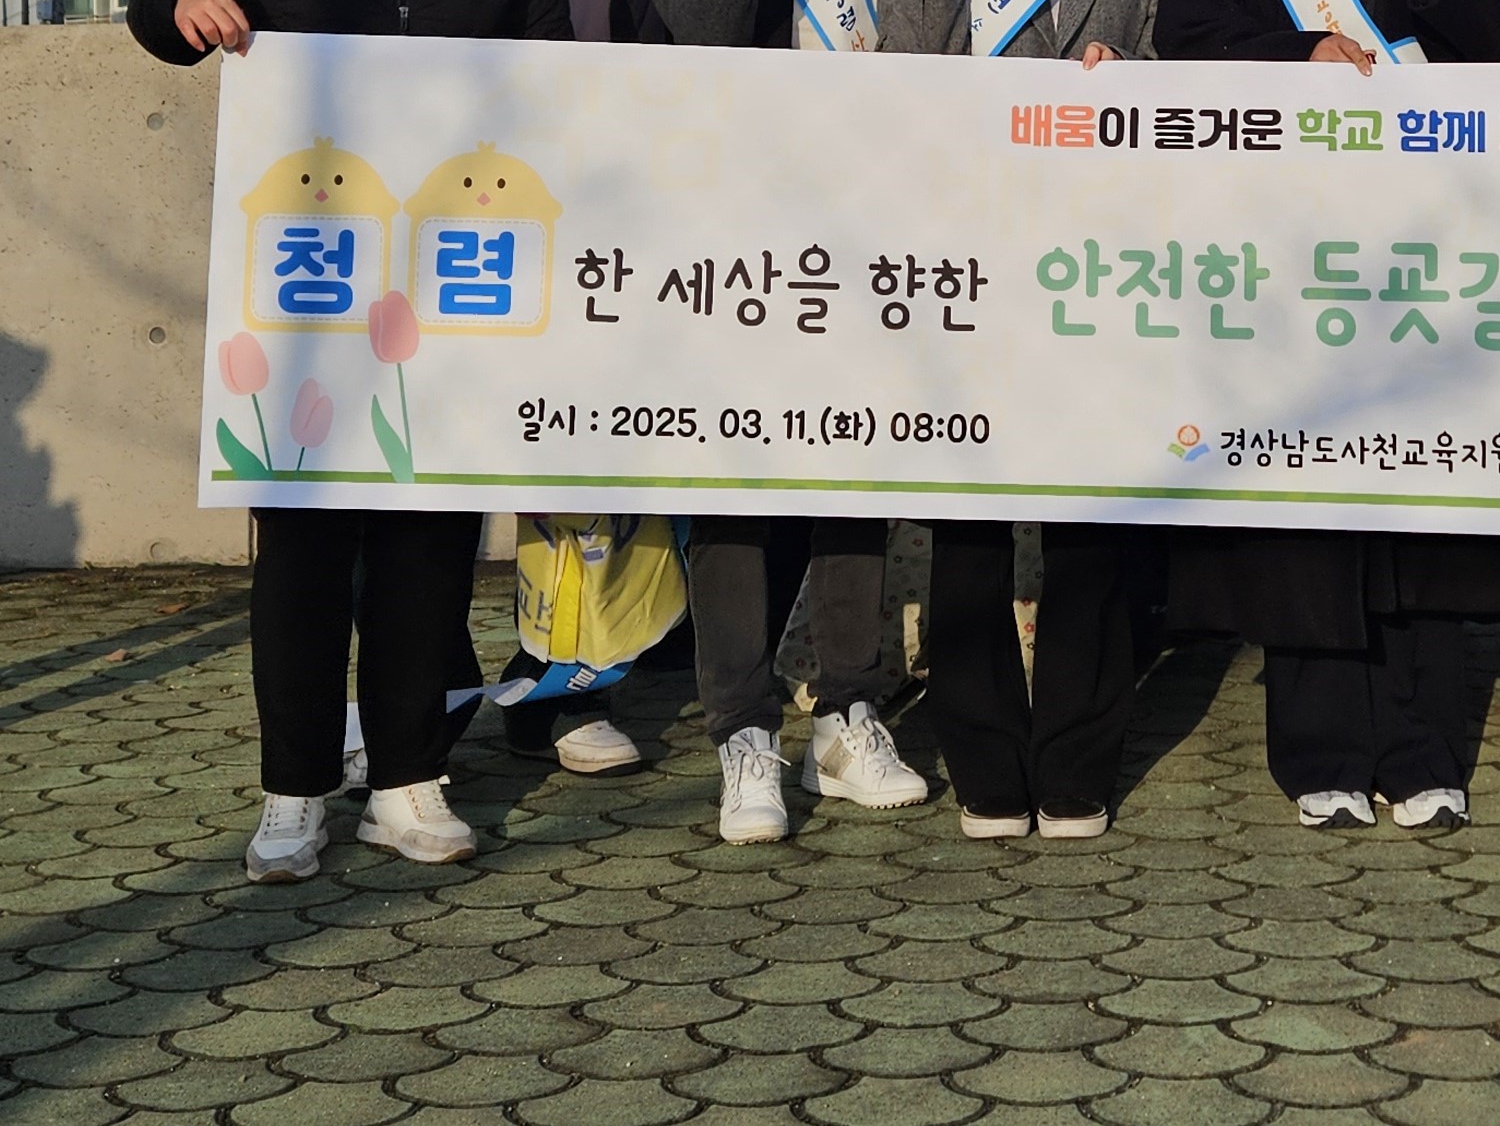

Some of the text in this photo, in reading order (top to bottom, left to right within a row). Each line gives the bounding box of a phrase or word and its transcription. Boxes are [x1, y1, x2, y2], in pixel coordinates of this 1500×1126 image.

[1011, 104, 1140, 149] 배움이
[1153, 107, 1284, 151] 즐거운
[1296, 108, 1384, 152] 학교
[1396, 109, 1486, 153] 함께
[656, 243, 841, 334] 세상을
[868, 253, 989, 332] 향한
[1035, 238, 1272, 341] 안전한
[610, 405, 706, 444] 2025.
[719, 408, 772, 445] 03.
[890, 411, 990, 445] 08:00
